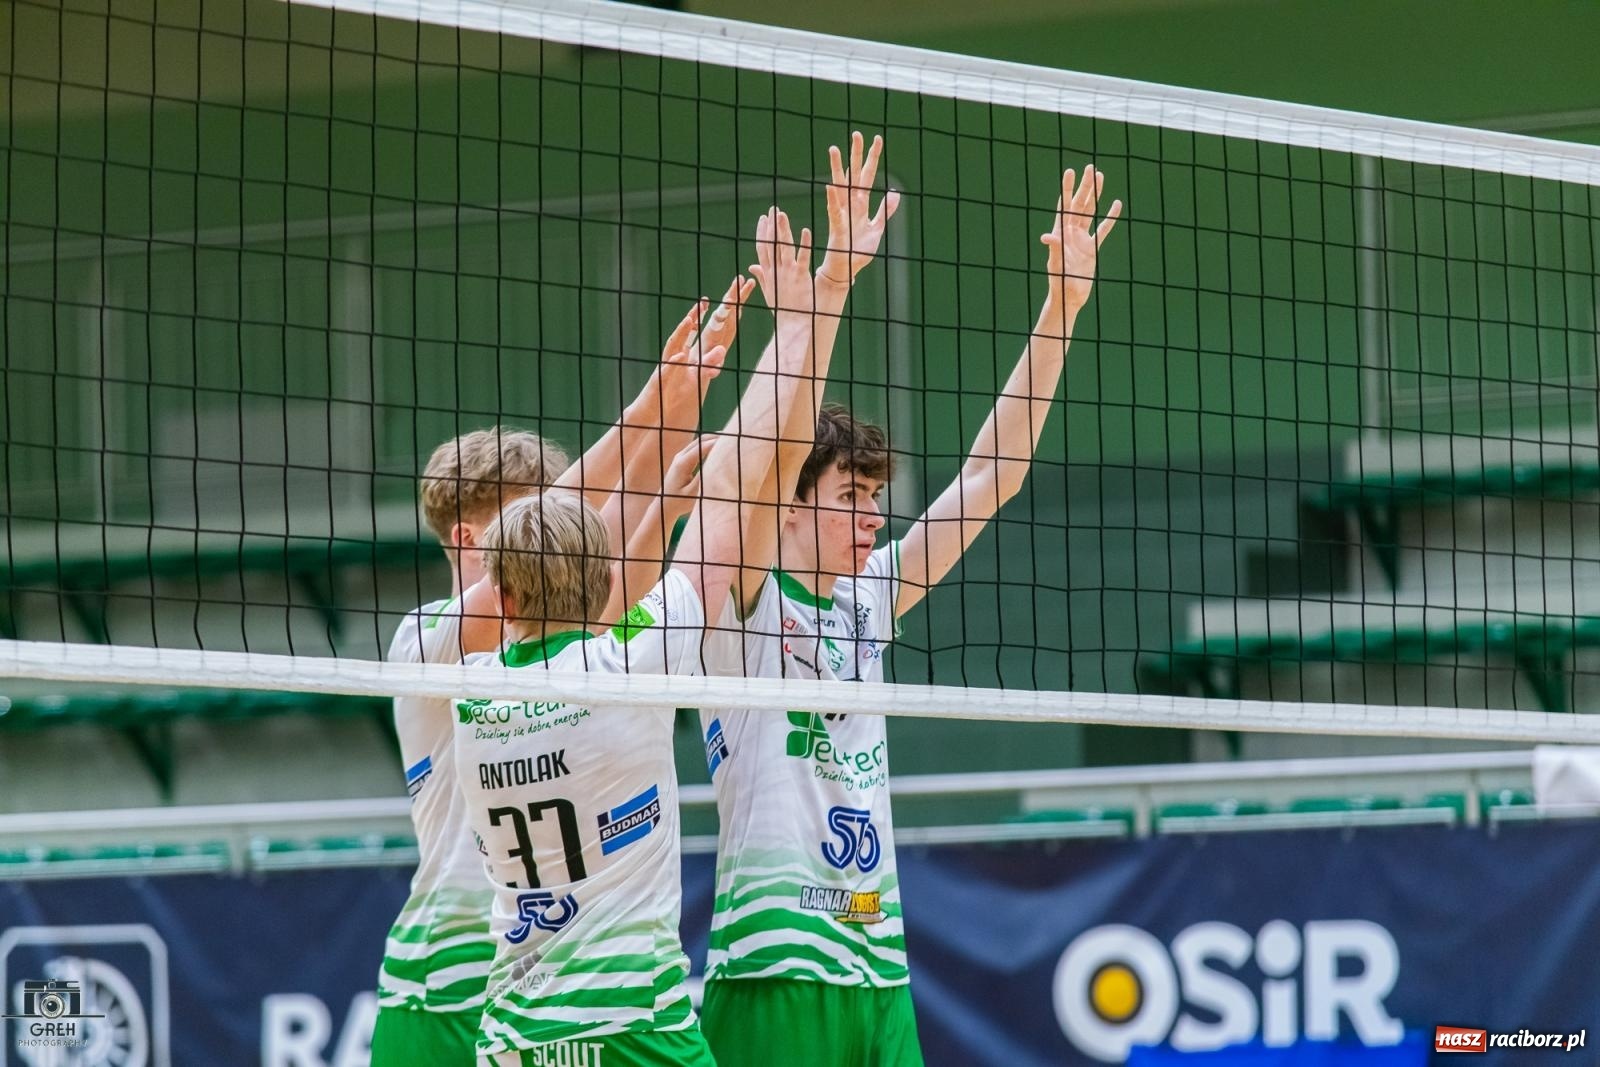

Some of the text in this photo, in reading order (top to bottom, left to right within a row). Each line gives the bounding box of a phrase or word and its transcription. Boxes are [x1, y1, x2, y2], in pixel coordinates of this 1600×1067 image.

[479, 749, 571, 790] ANTOLAK
[602, 802, 660, 840] BUDMAR
[488, 798, 587, 889] 37
[801, 886, 851, 913] RAGNAR
[532, 1042, 605, 1067] SCOUT
